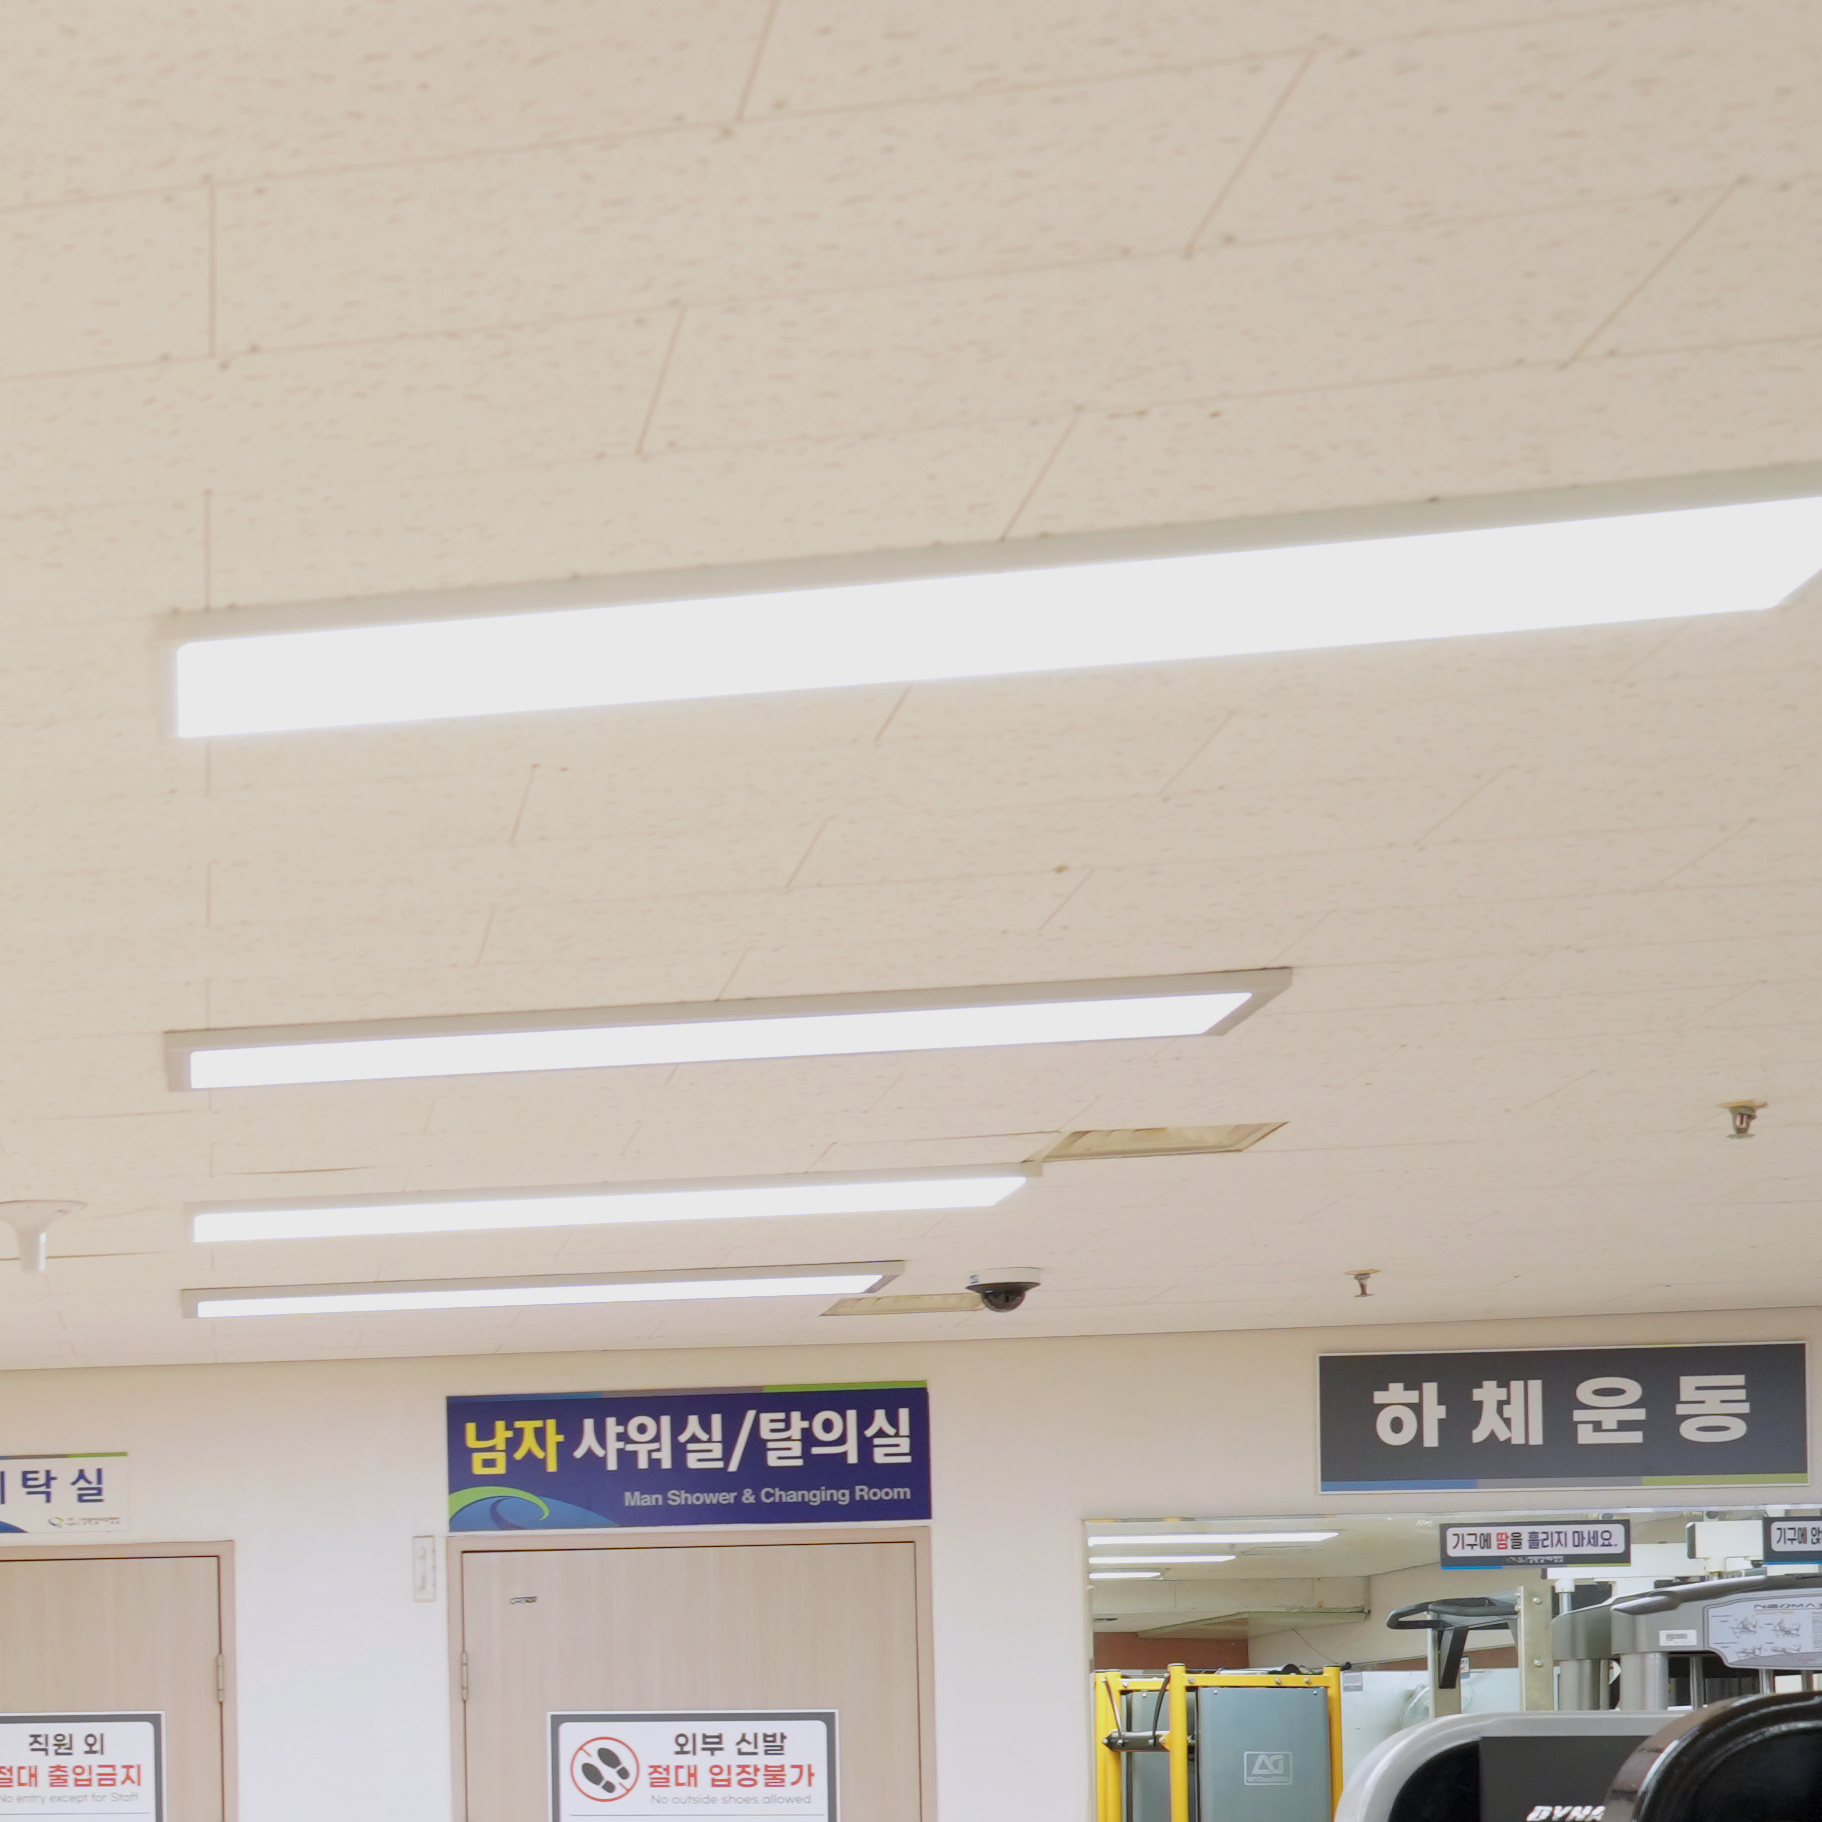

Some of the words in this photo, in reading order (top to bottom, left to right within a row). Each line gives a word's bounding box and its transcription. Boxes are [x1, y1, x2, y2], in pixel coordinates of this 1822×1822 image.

[1373, 1374, 1750, 1448] 하체운동
[465, 1419, 564, 1475] 남자
[573, 1407, 912, 1472] 샤워실/탈의실
[624, 1491, 663, 1507] Man
[667, 1489, 738, 1506] Shower
[742, 1489, 756, 1503] &
[760, 1486, 850, 1506] Changing
[855, 1485, 911, 1501] Room
[1452, 1532, 1491, 1550] 기구에
[1496, 1532, 1522, 1549] 땀을
[1528, 1531, 1567, 1549] 흘리지
[1776, 1527, 1807, 1545] 기구에
[28, 1733, 74, 1756] 직원
[83, 1733, 105, 1756] 외
[674, 1733, 724, 1756] 외부
[736, 1732, 787, 1756] 신발
[48, 1764, 141, 1787] 출입금지
[648, 1765, 698, 1788] 절대
[709, 1764, 815, 1788] 입장불가
[16, 1793, 45, 1805] entry
[49, 1793, 88, 1804] except
[90, 1793, 108, 1803] for
[651, 1795, 668, 1804] No
[671, 1795, 719, 1805] outside
[722, 1795, 759, 1805] shoes
[763, 1794, 811, 1804] allowed
